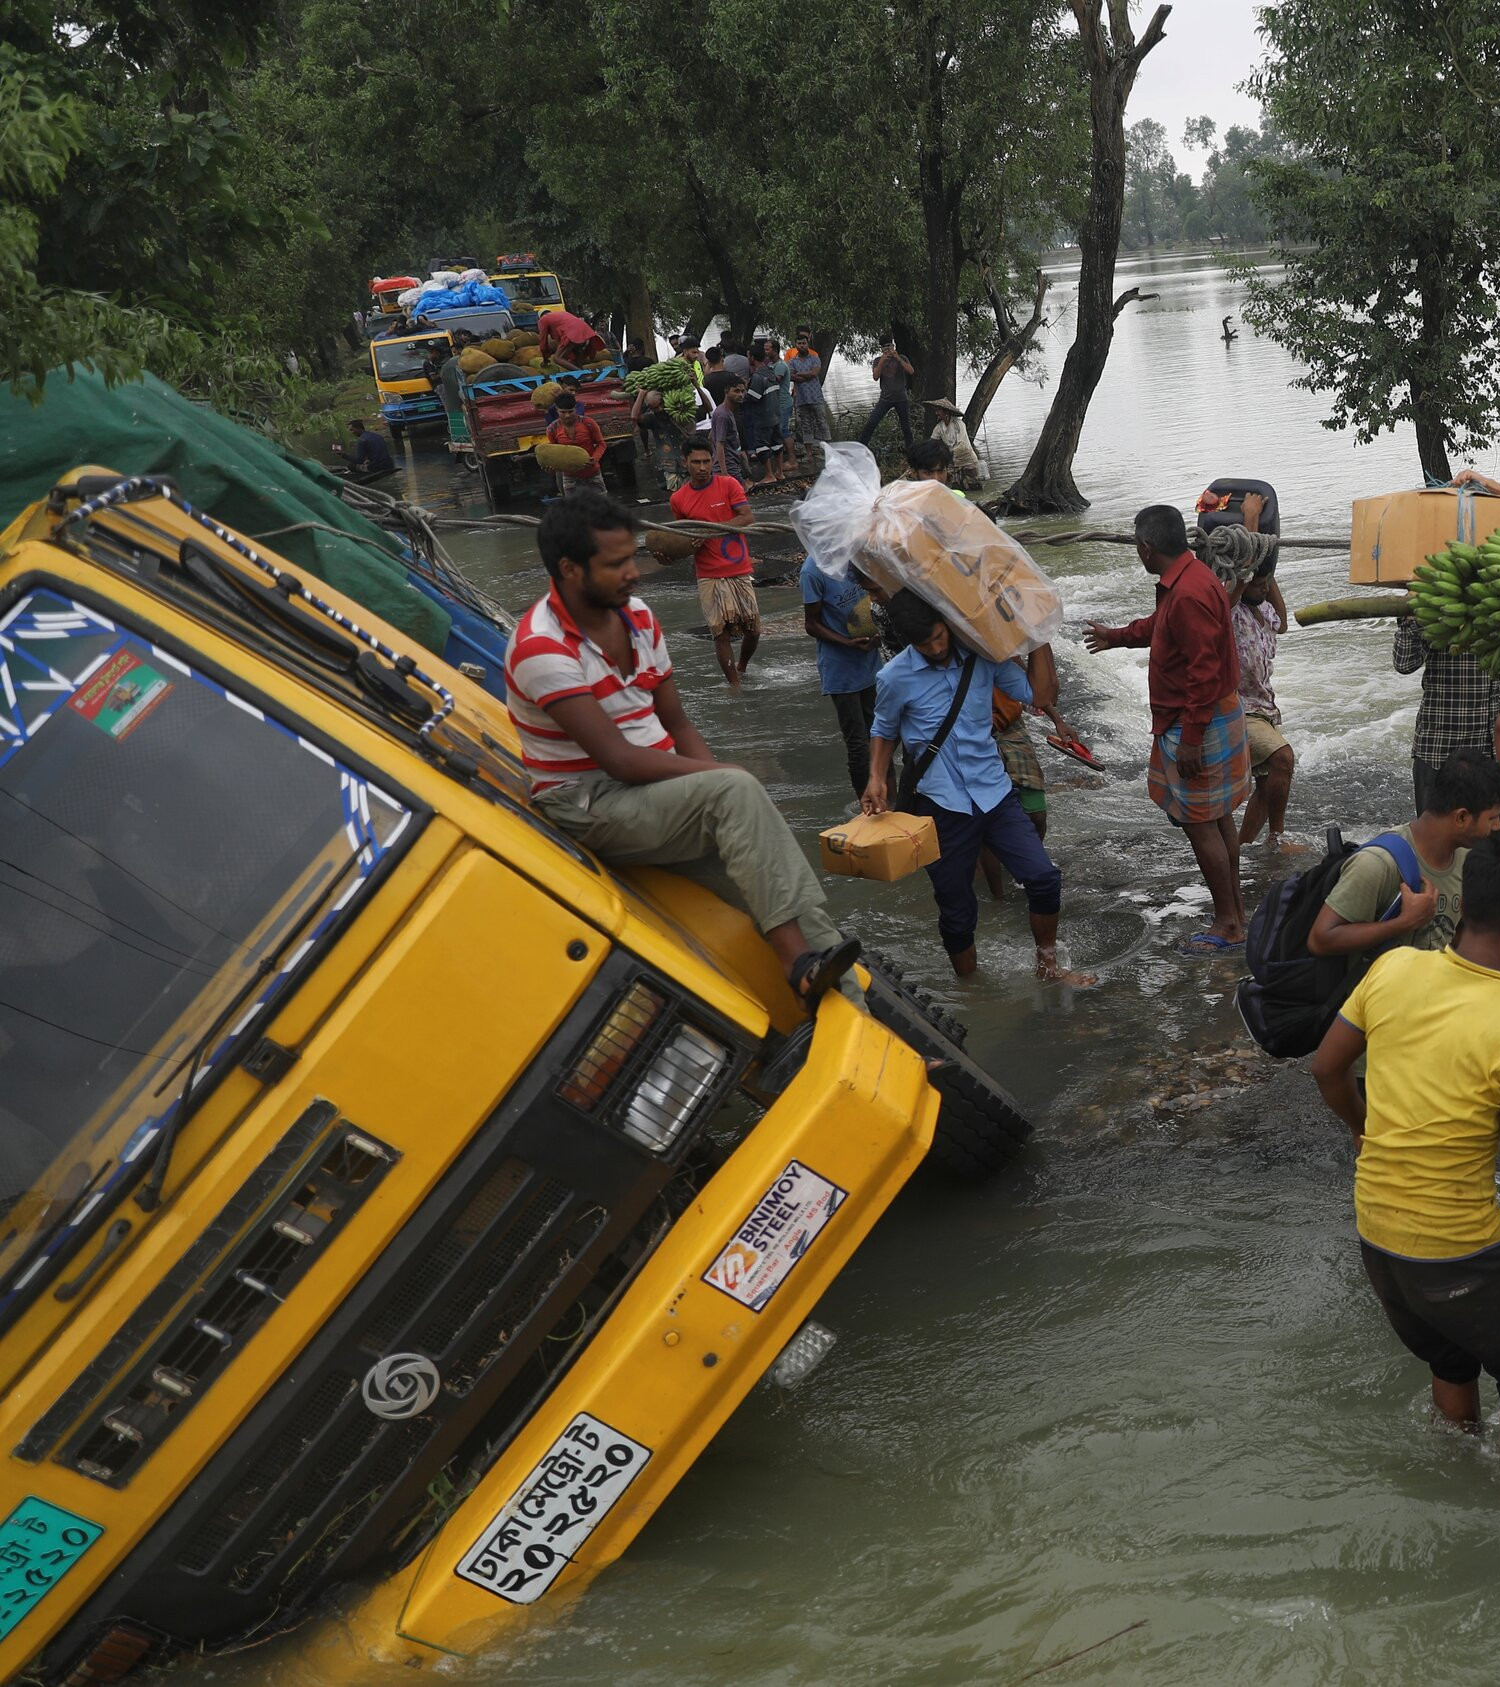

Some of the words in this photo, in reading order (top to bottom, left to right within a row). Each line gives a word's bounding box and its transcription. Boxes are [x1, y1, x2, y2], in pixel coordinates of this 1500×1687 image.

[738, 1165, 801, 1244] BINIMOY
[752, 1201, 801, 1253] STEEL
[806, 1207, 816, 1221] MS
[816, 1190, 831, 1207] Rod
[783, 1228, 803, 1250] Angle
[746, 1272, 769, 1300] Square
[766, 1258, 781, 1273] Bar
[496, 1443, 634, 1592] ২০-২৫২০
[466, 1516, 533, 1581] ঢাকা
